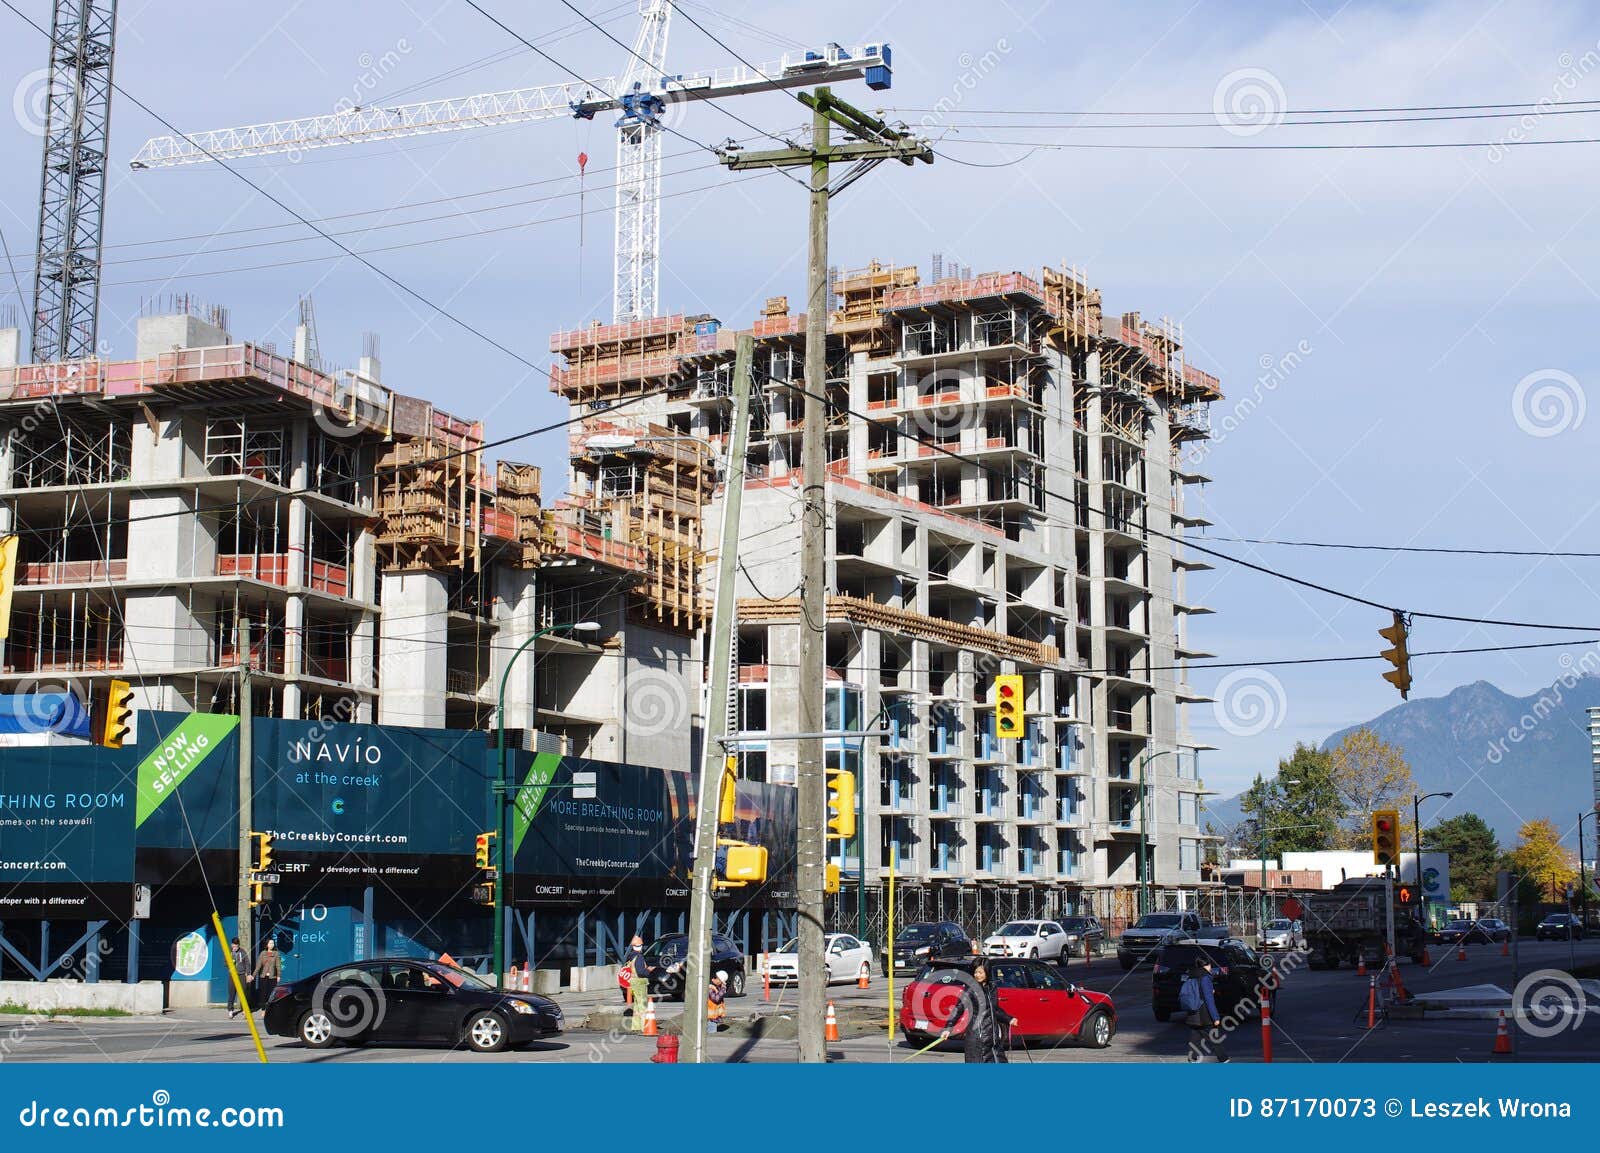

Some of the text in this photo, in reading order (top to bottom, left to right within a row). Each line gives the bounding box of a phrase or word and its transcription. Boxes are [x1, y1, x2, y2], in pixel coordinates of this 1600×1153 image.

[153, 732, 188, 771] NOW
[296, 737, 381, 764] NAVÍO
[152, 734, 209, 794] SELLING
[296, 772, 379, 786] at the creek
[65, 793, 125, 808] ROOM
[550, 800, 663, 822] MORE BREATHING ROOM
[41, 818, 56, 826] the
[59, 817, 93, 826] seawall
[266, 829, 408, 844] TheCreekbyConcert.com
[575, 857, 640, 869] TheCreekbyConcert.com
[327, 865, 360, 876] developer
[362, 865, 378, 874] with
[385, 865, 418, 874] difference
[24, 896, 40, 905] with
[49, 896, 85, 905] difference
[292, 930, 327, 944] reek
